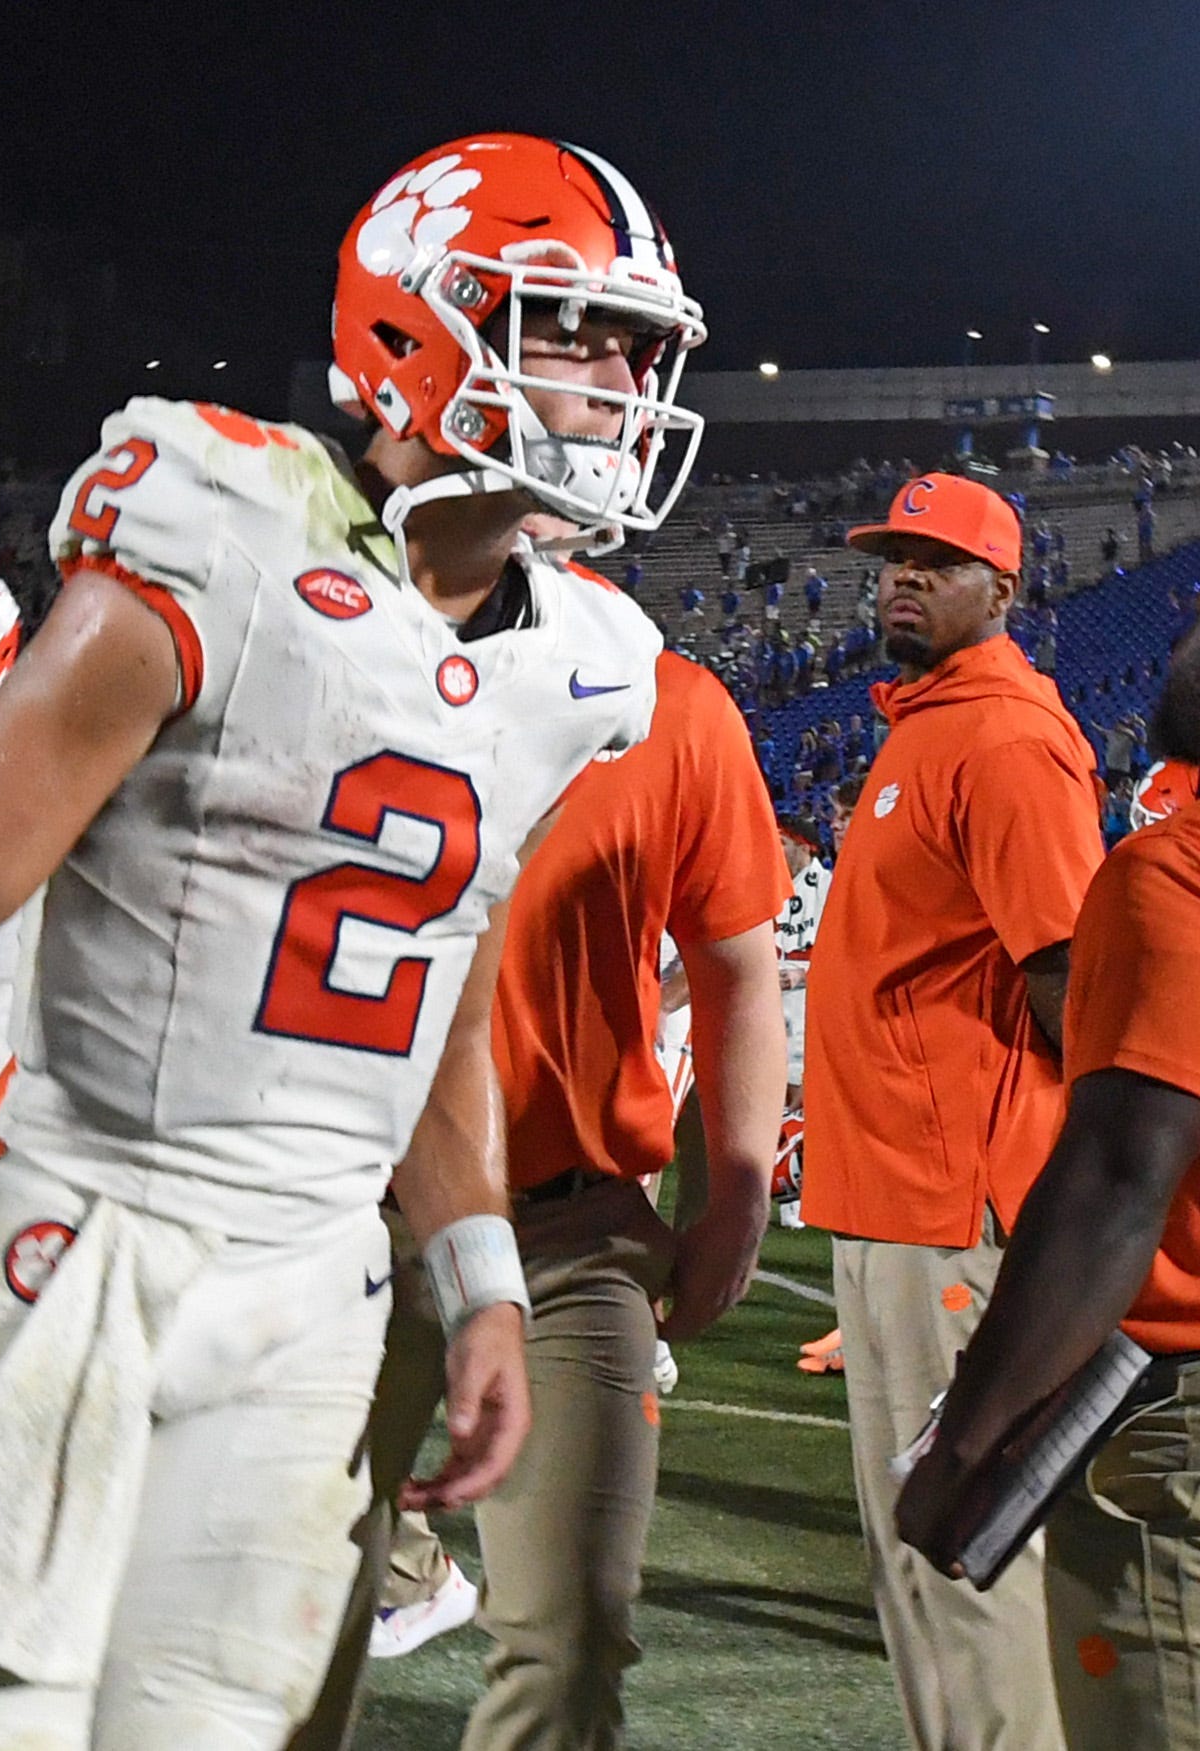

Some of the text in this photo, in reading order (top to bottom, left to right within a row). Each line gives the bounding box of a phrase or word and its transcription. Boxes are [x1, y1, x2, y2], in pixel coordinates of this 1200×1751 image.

[67, 436, 159, 542] 2
[903, 479, 937, 516] C
[305, 576, 365, 609] ACC
[252, 748, 482, 1058] 2
